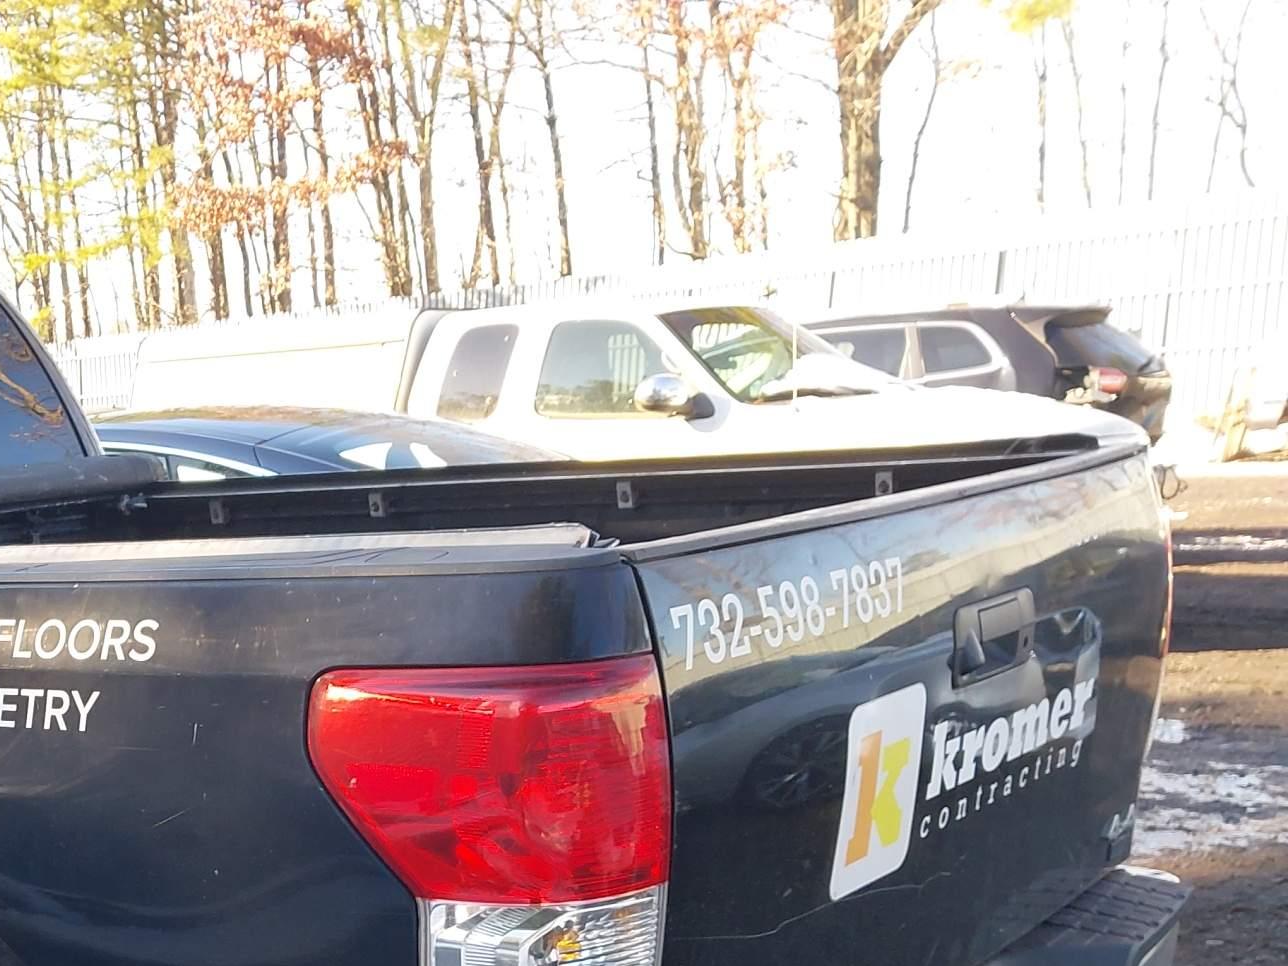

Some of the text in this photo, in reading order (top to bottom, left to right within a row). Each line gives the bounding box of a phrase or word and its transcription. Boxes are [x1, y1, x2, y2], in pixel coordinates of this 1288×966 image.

[669, 556, 903, 671] 732-598-7837
[919, 739, 1082, 839] contracting
[925, 676, 1096, 801] kromer
